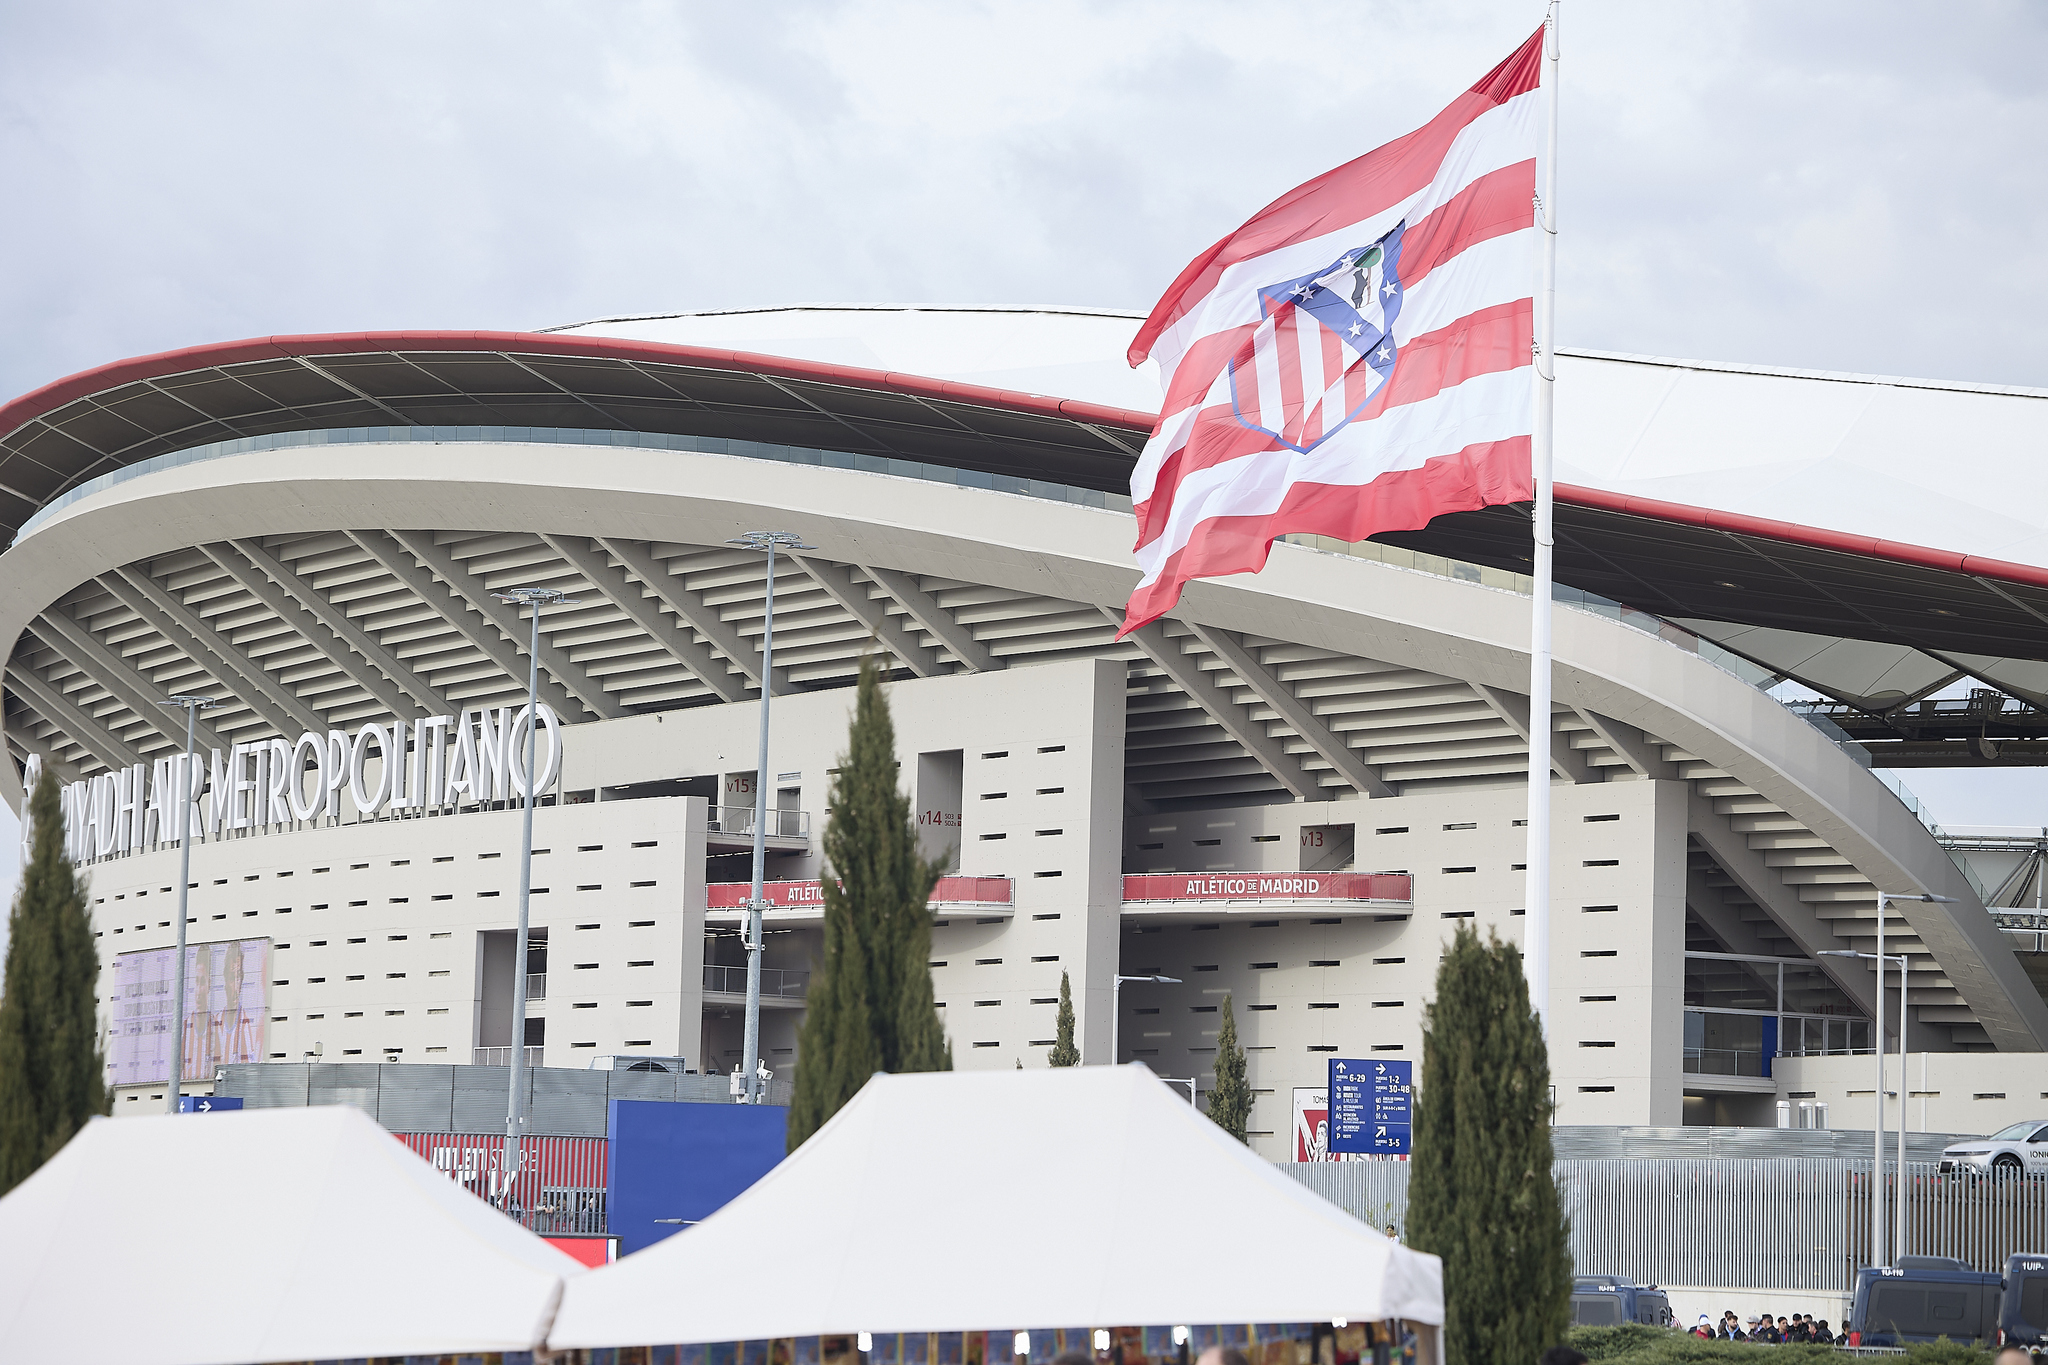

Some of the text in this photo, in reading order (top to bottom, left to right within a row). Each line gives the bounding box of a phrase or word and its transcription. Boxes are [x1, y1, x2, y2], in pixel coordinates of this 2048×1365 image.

[144, 753, 205, 846] AIR
[208, 703, 562, 832] METROPOLITANO
[919, 810, 942, 825] v14
[1301, 831, 1323, 847] v13
[788, 883, 825, 902] ATLÉTIC
[1186, 876, 1245, 895] ATLÉTICO
[1259, 879, 1319, 894] MADRID
[1349, 1074, 1366, 1083] 6-29
[1389, 1085, 1410, 1094] 30-48
[1388, 1138, 1400, 1147] 3-5
[492, 1148, 537, 1171] STRE
[2030, 1151, 2048, 1159] IONI
